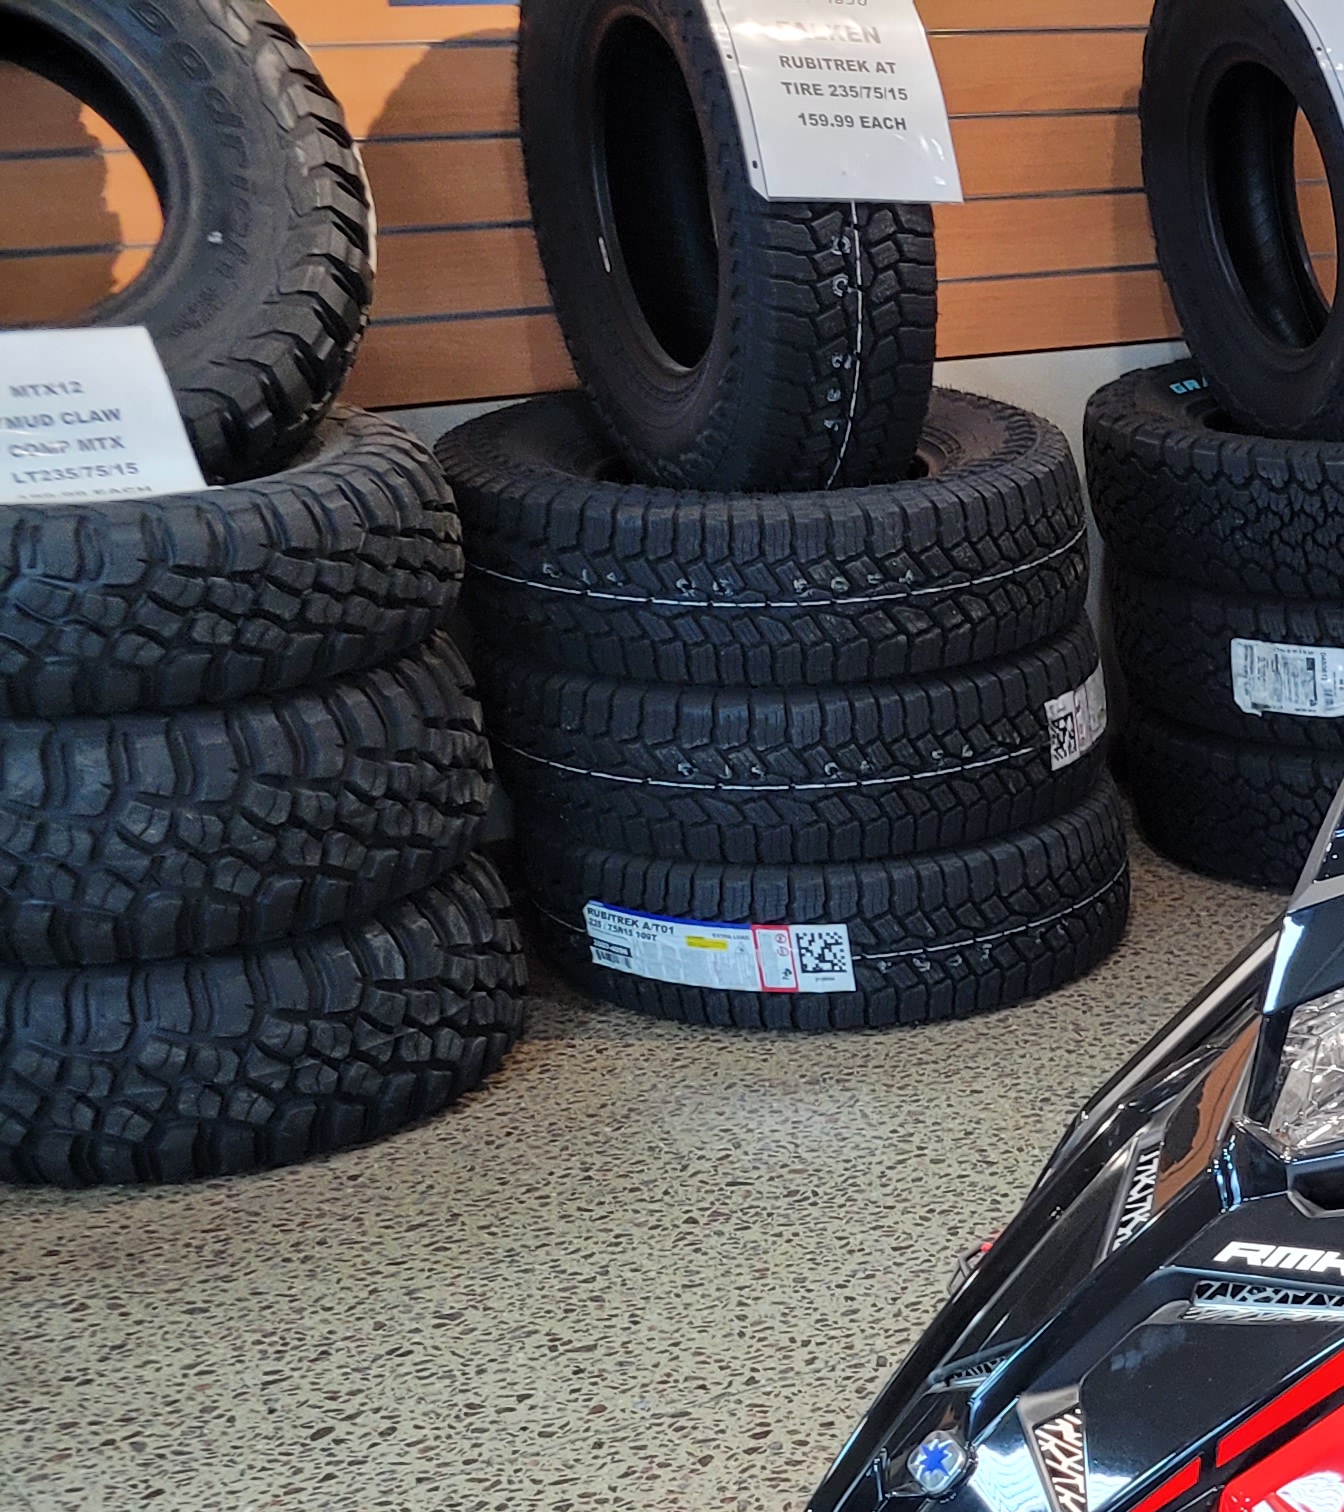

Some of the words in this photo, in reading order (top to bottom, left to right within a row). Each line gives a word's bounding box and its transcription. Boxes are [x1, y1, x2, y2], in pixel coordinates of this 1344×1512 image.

[779, 55, 871, 73] RUBITREK
[875, 62, 896, 74] AT
[781, 81, 825, 96] TIRE
[828, 83, 909, 101] 235/75/15
[798, 113, 855, 128] 159.99
[859, 115, 908, 131] EACH
[9, 381, 85, 398] MTX12
[60, 408, 121, 425] CLAW
[8, 441, 70, 458] COMP
[76, 436, 126, 452] MTX
[10, 462, 140, 484] LT235/75/15
[586, 906, 640, 928] RUBITREK
